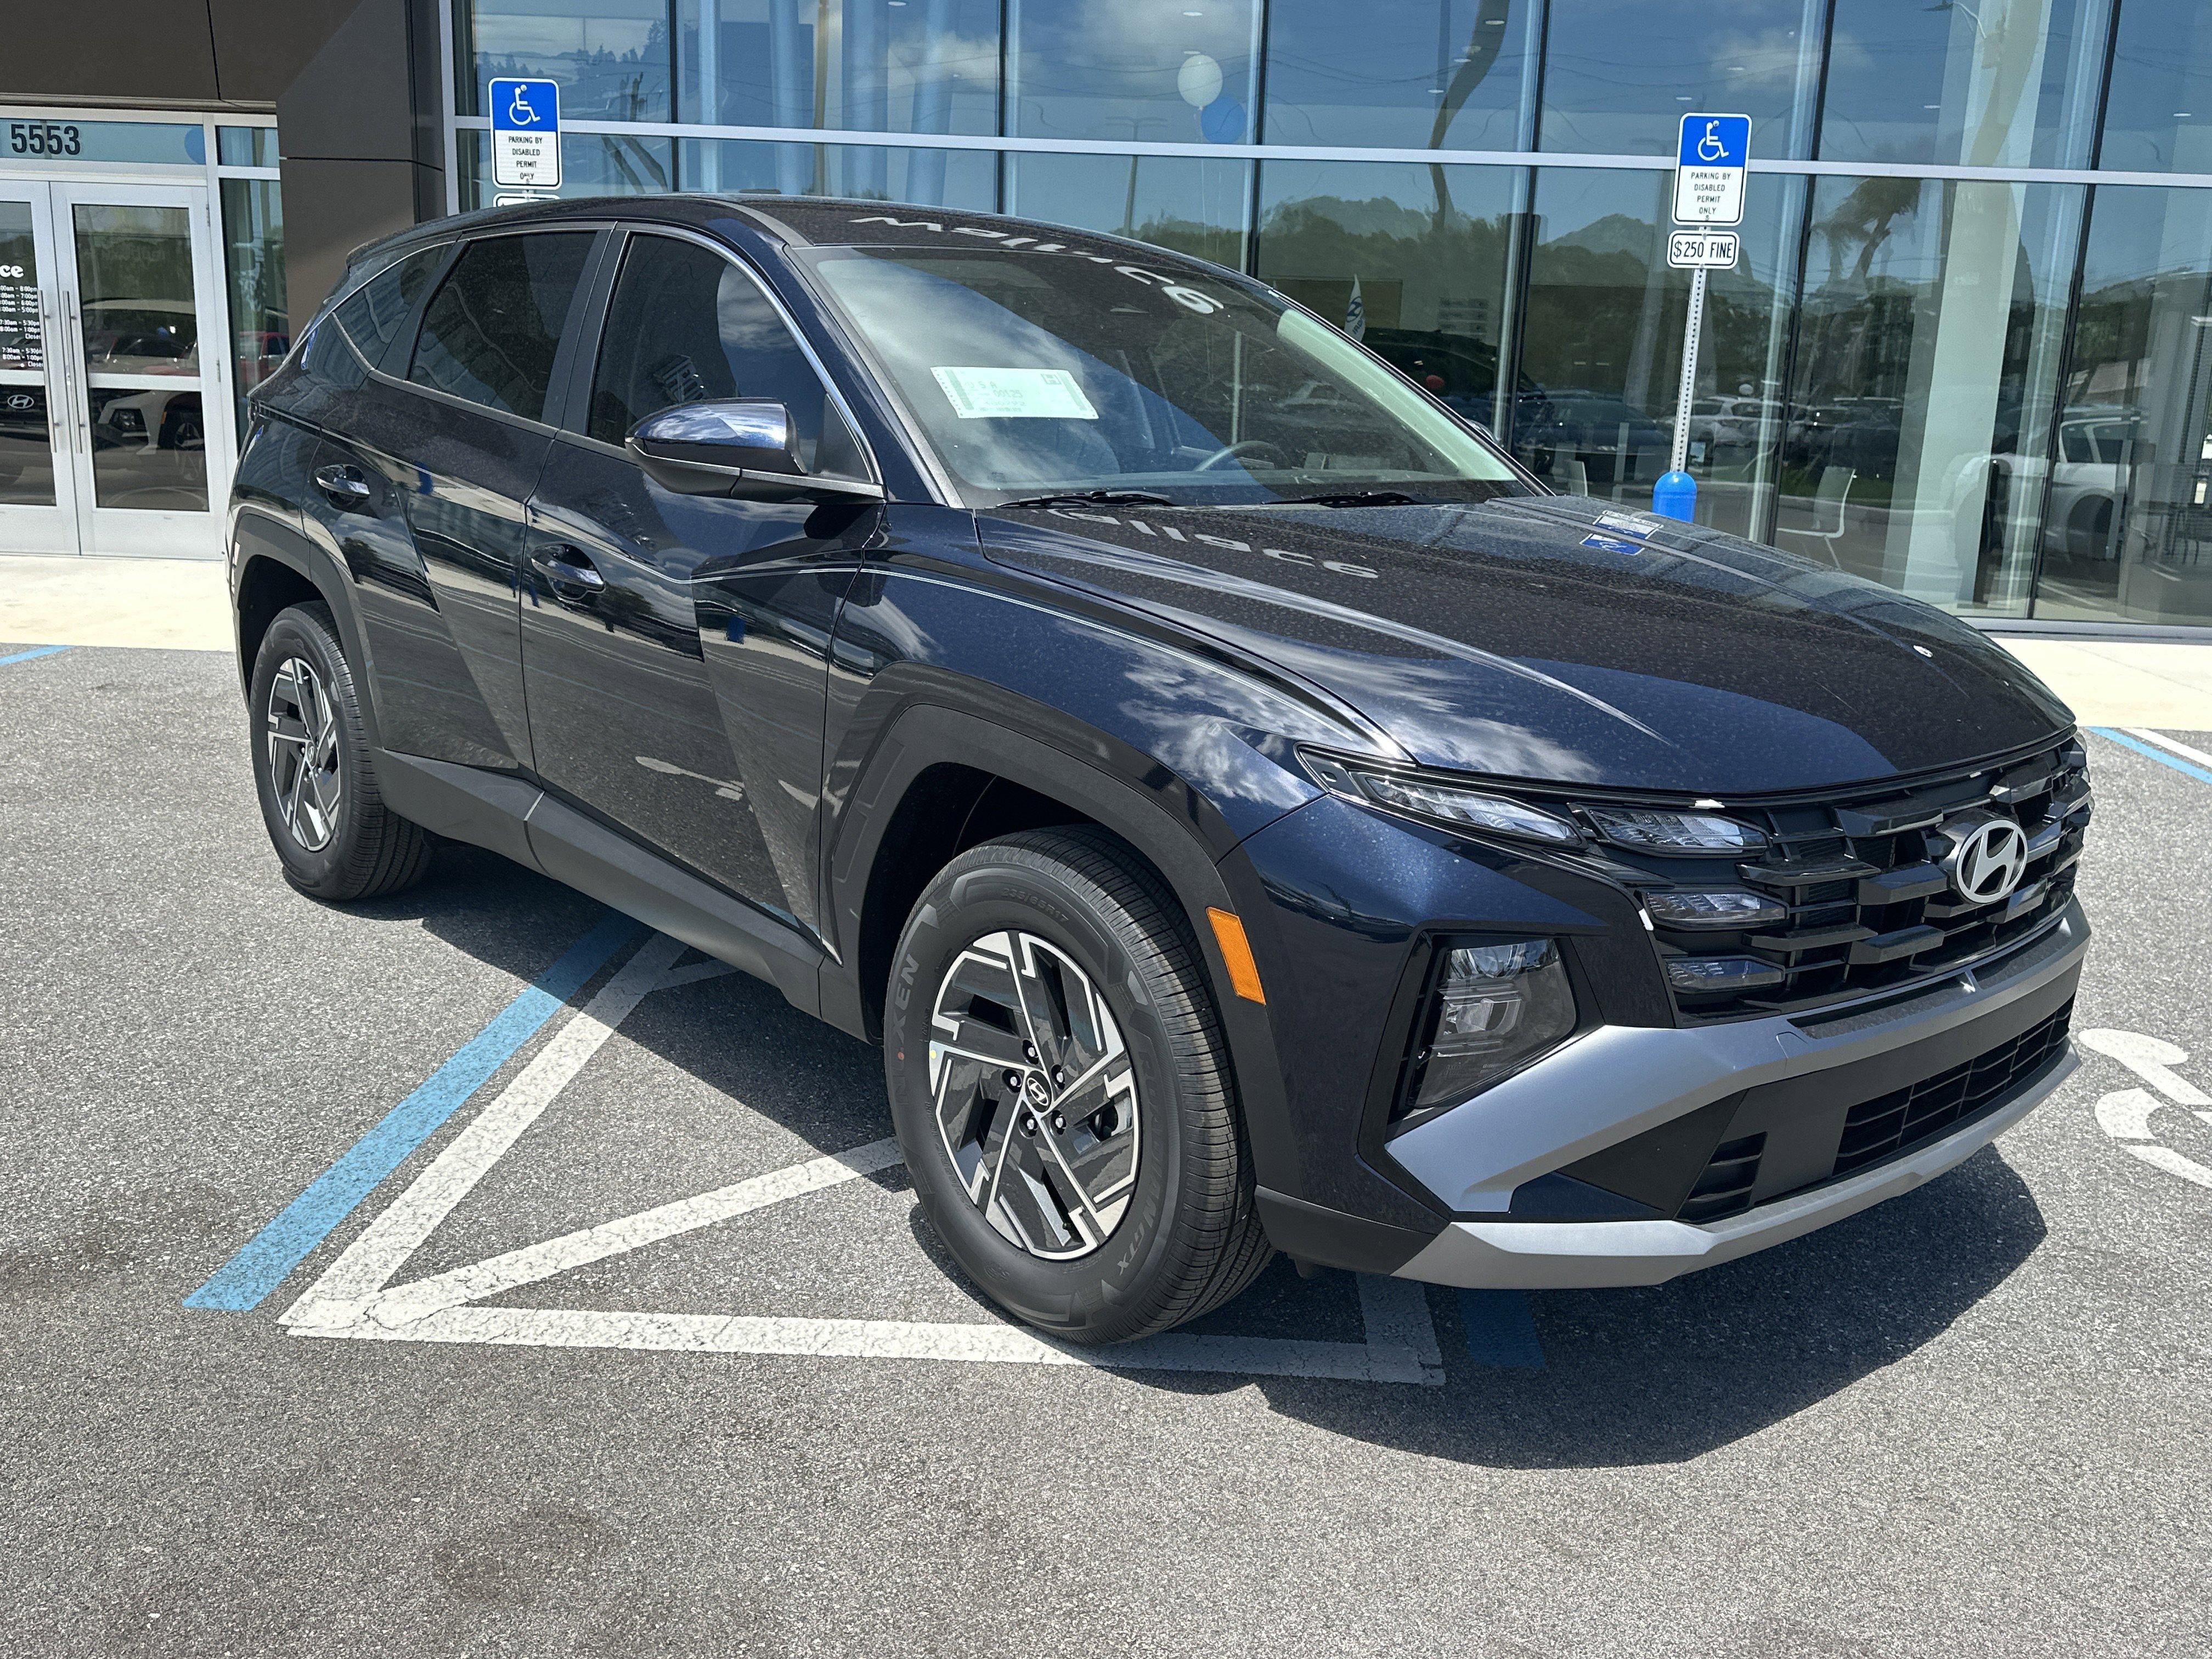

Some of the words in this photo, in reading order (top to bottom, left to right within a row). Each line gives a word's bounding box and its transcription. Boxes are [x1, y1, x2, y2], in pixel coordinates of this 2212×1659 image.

[11, 124, 80, 155] 5553
[1691, 172, 1719, 180] PARKING
[1694, 184, 1725, 192] DISABLED
[1697, 195, 1720, 204] PERMIT
[1699, 207, 1716, 215] ONLY
[1673, 239, 1704, 258] $250
[1710, 242, 1733, 258] FINE
